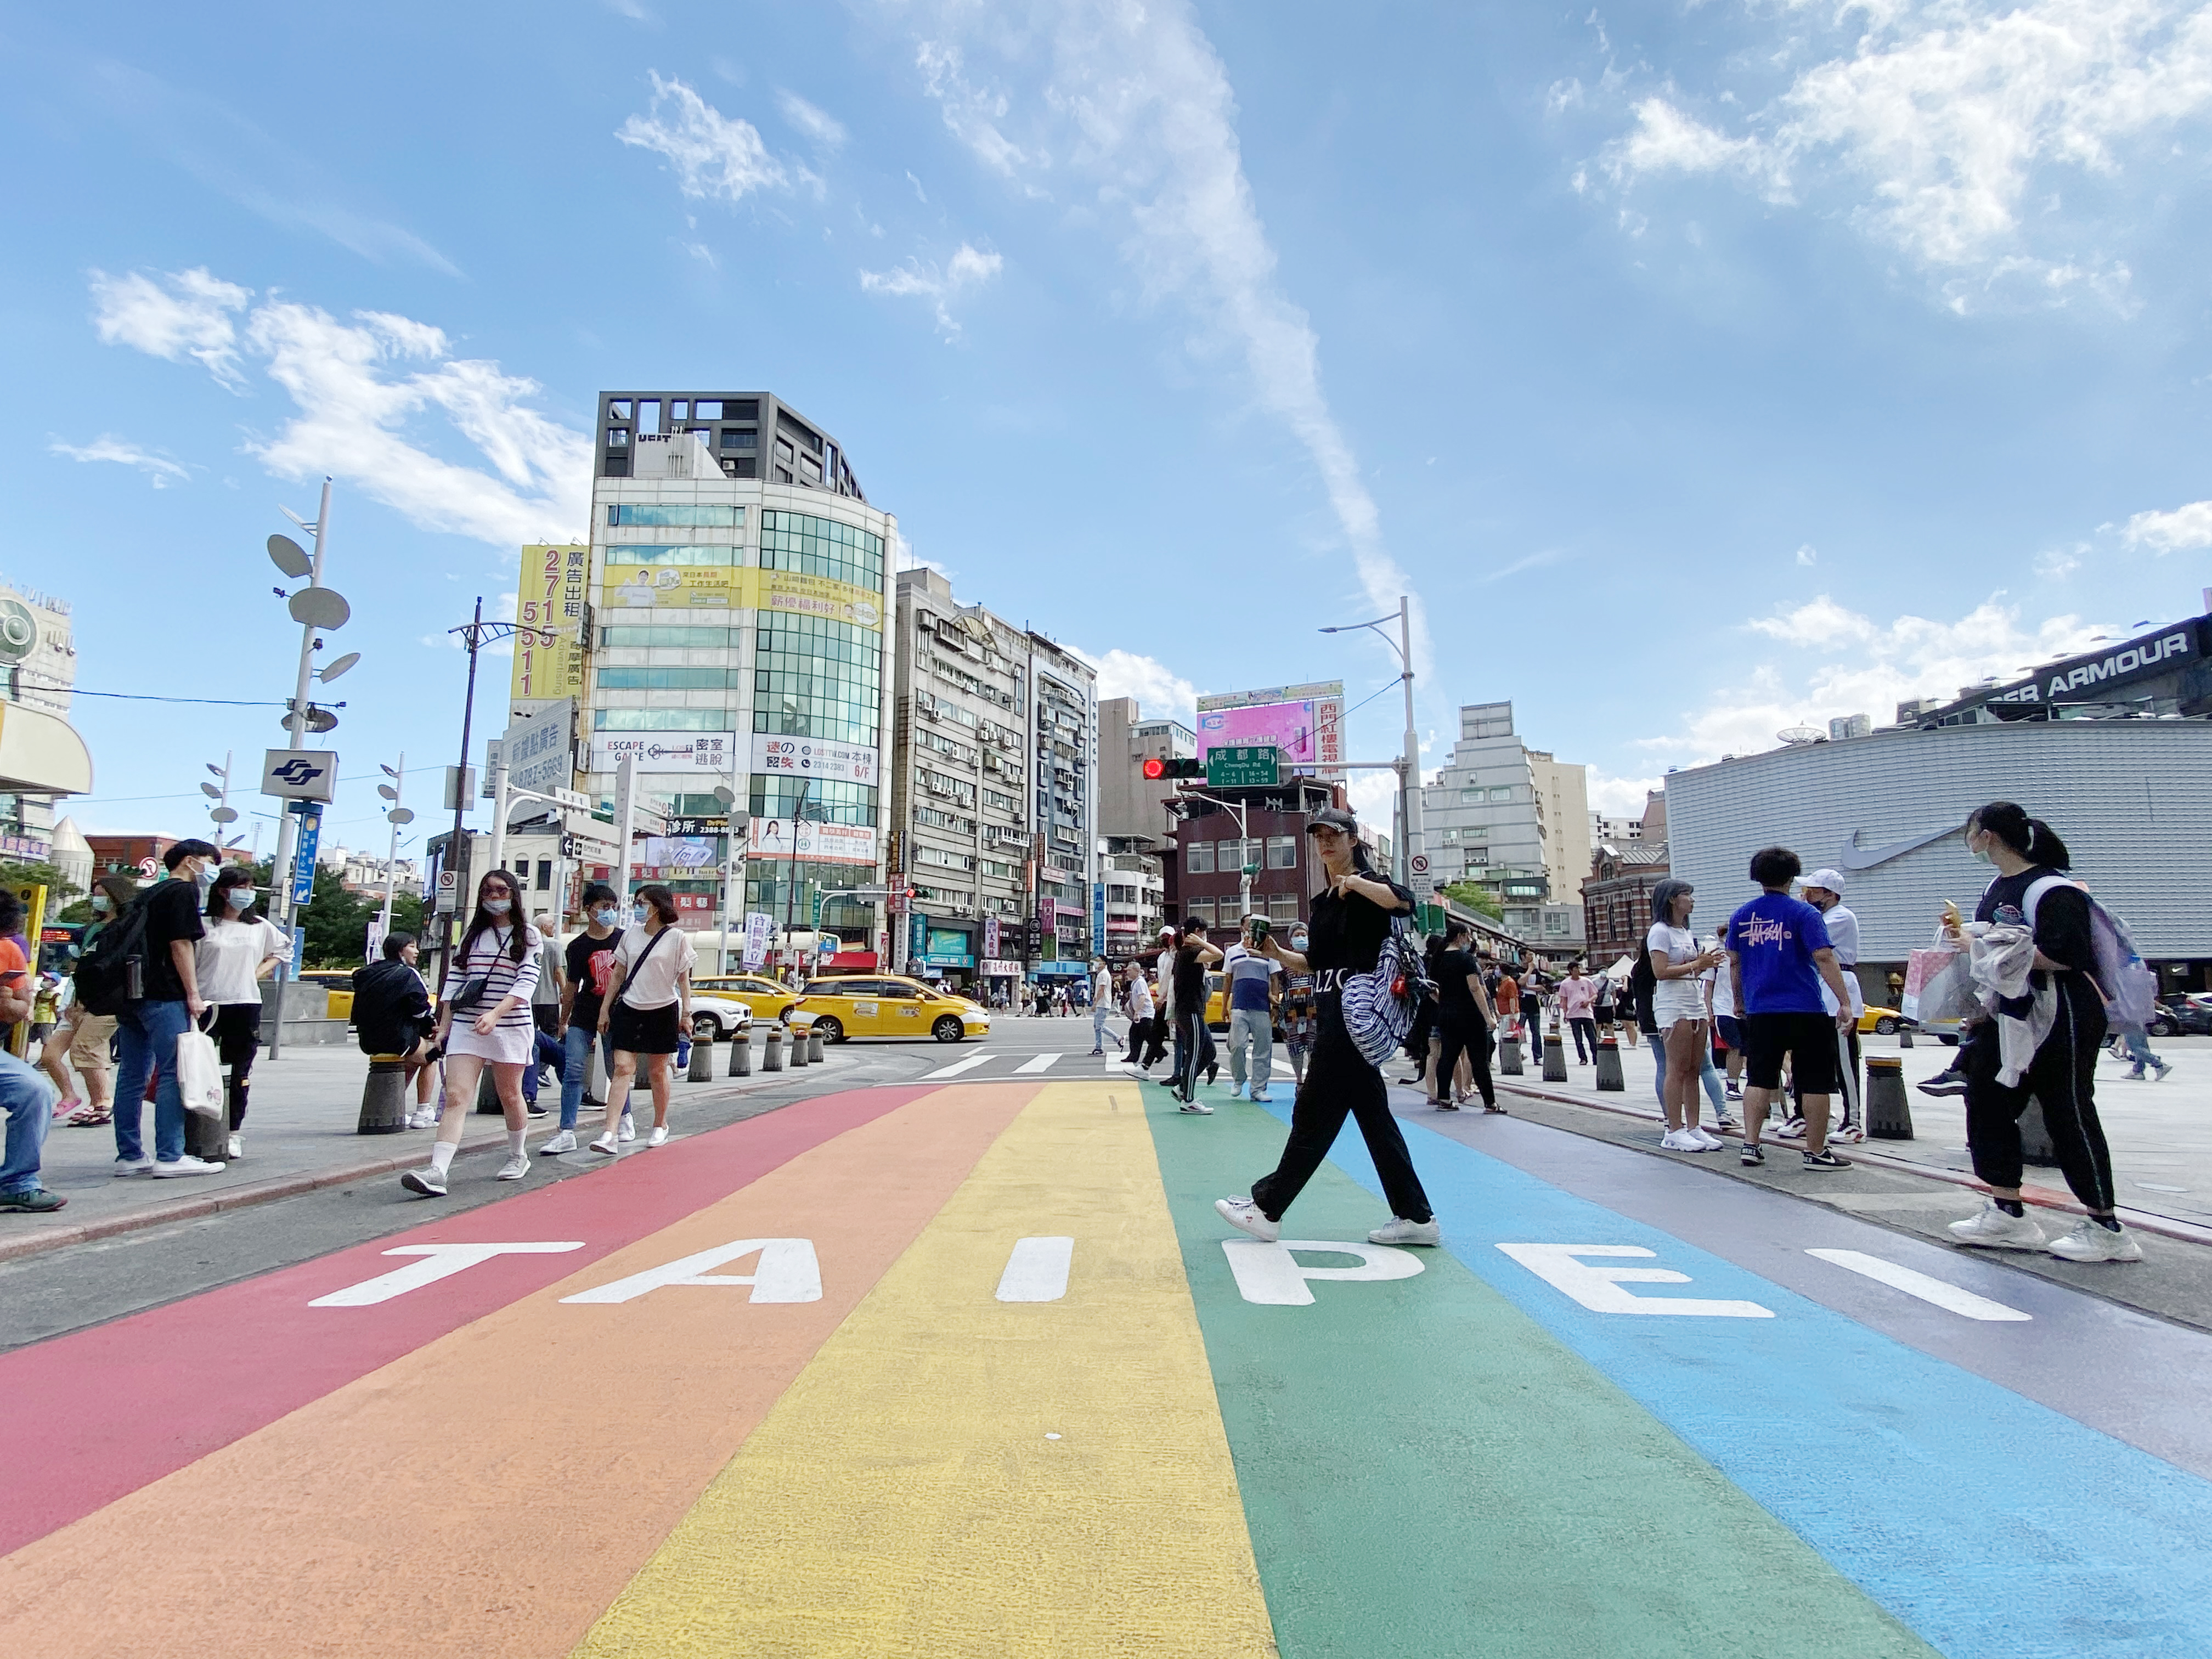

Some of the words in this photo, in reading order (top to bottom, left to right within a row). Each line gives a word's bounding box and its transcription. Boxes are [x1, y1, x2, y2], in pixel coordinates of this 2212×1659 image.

[563, 552, 584, 617] 廣告出租
[2047, 632, 2188, 697] ARMOUR
[1987, 684, 2039, 702] ER
[607, 741, 644, 750] ESCAPE
[696, 738, 723, 751] 密室
[615, 753, 644, 761] GAE
[696, 753, 722, 765] 逃脫
[1214, 748, 1271, 760] 成都路
[308, 1235, 2034, 1322] TAIPEI
